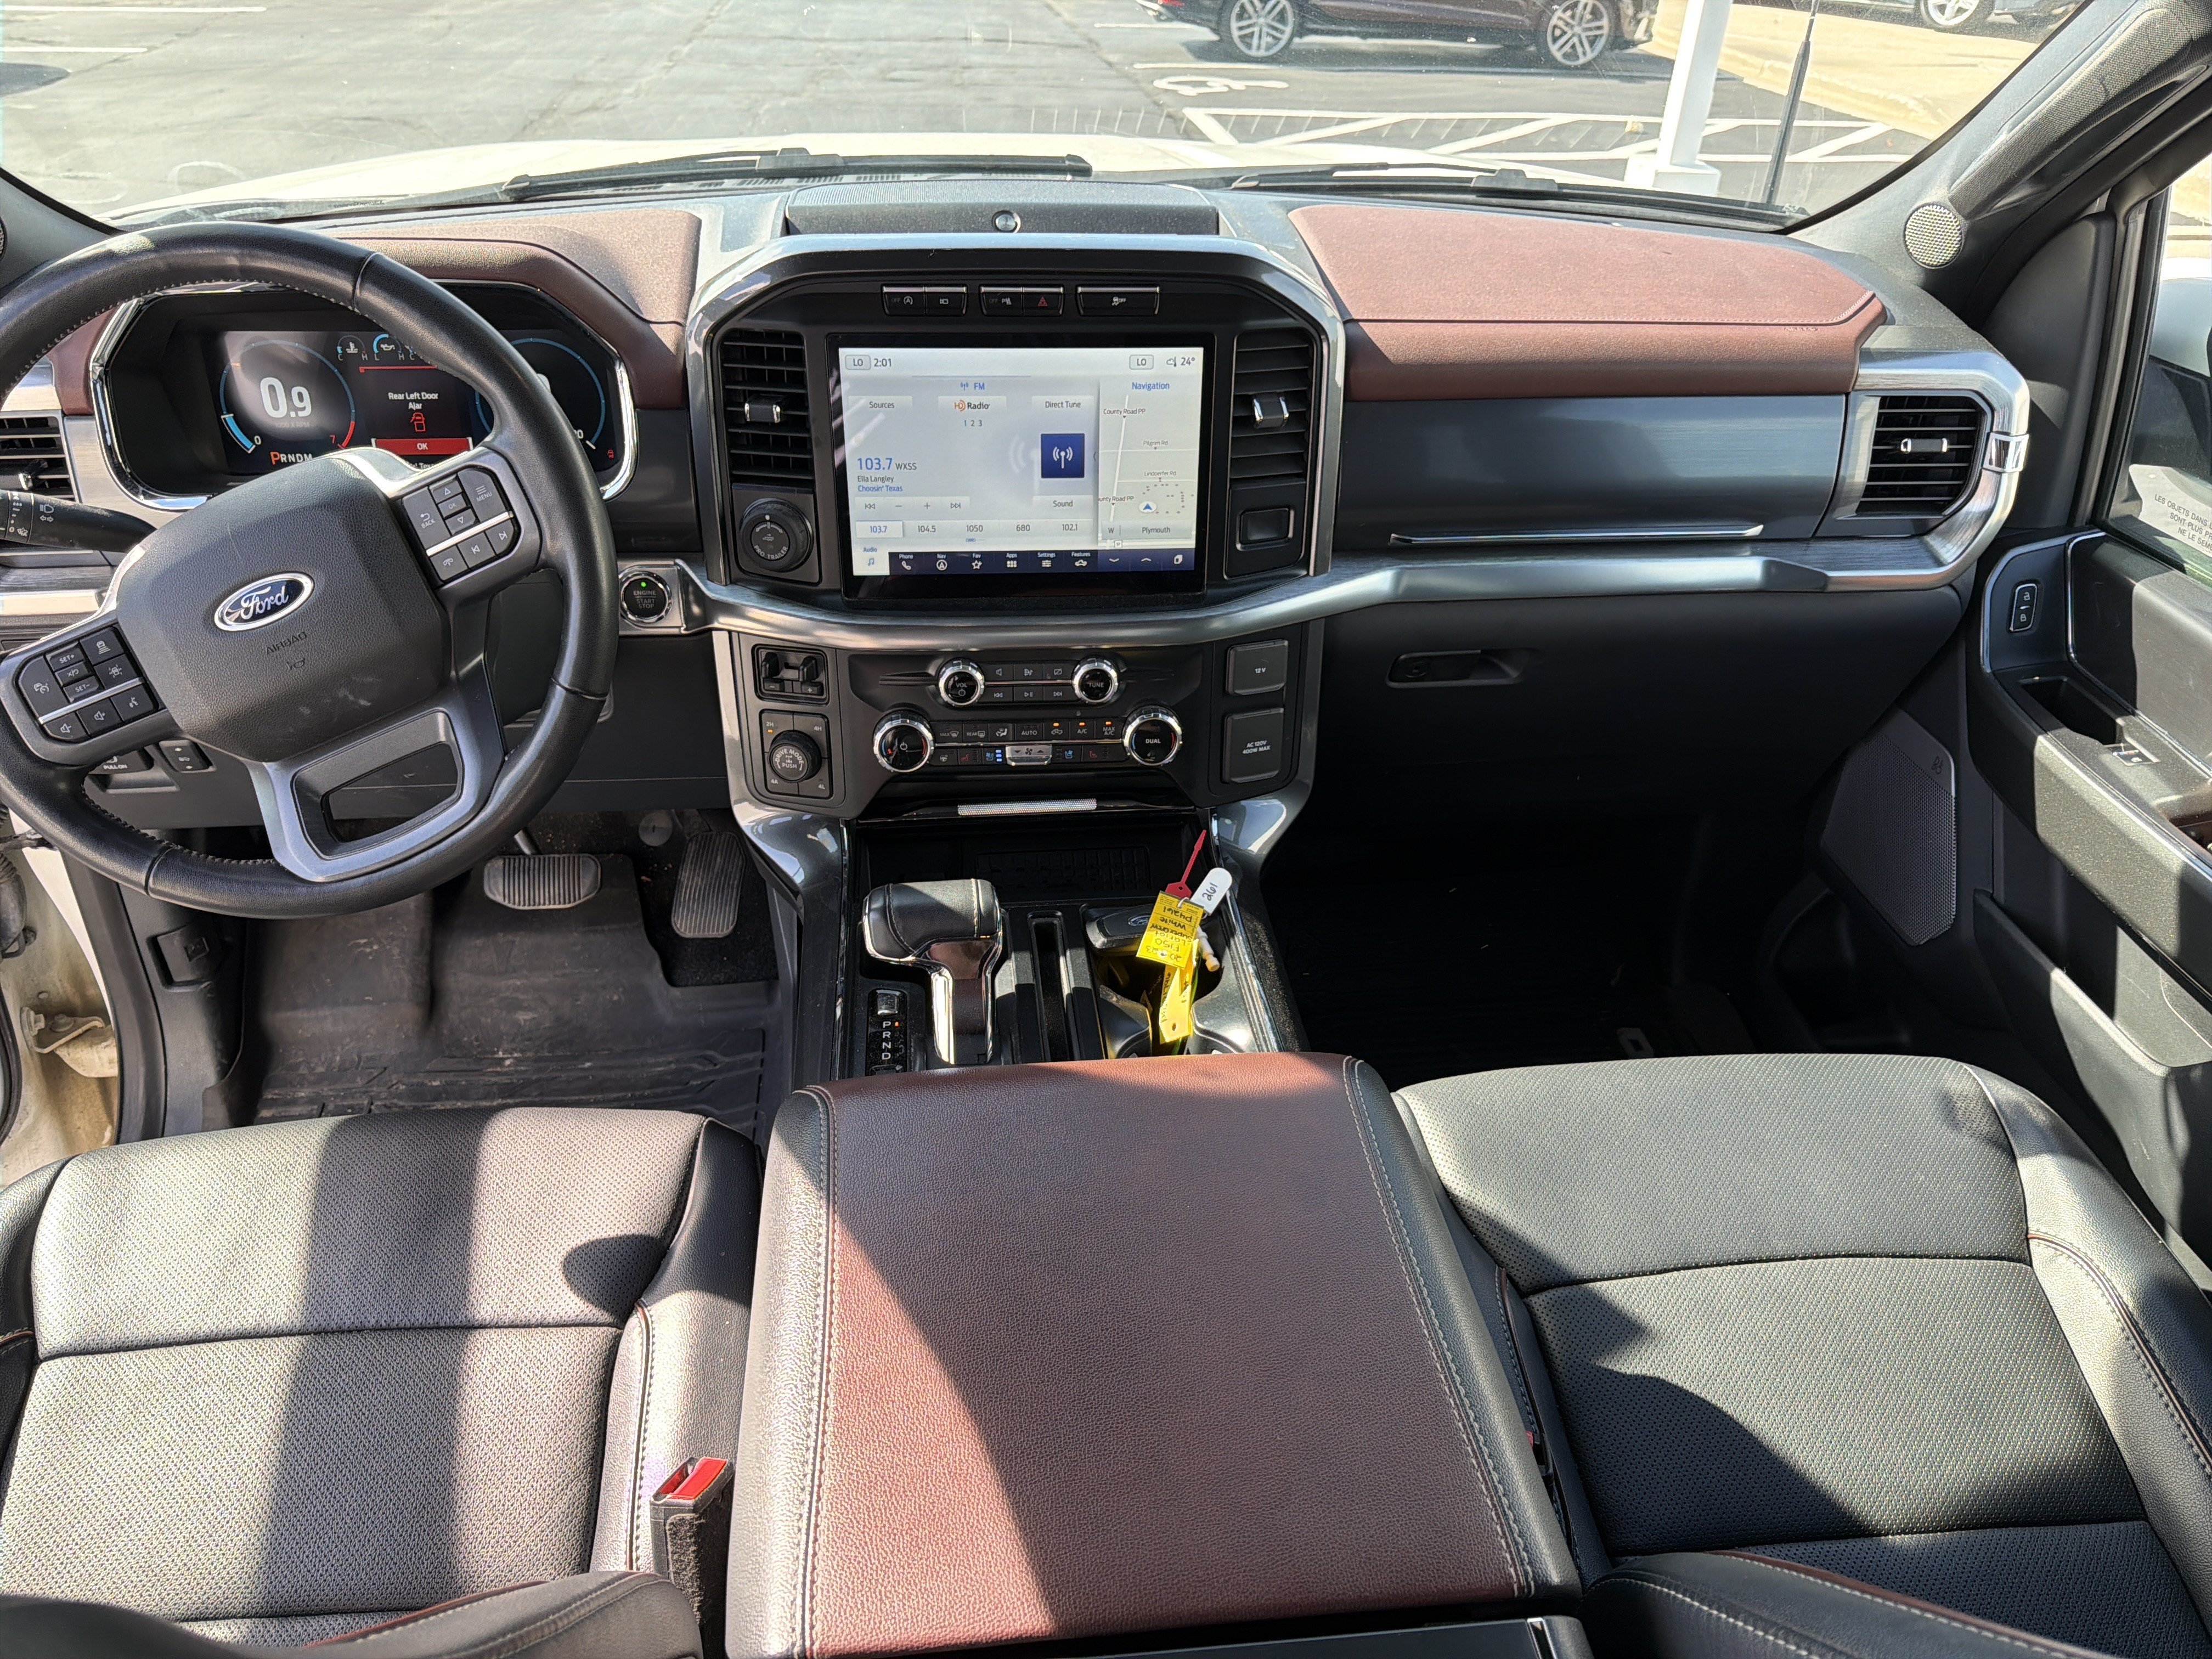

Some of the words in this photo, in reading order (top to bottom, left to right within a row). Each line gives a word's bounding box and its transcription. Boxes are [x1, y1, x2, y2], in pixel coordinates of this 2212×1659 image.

[853, 358, 864, 366] LO
[873, 358, 892, 367] 2:01
[1132, 382, 1170, 391] Navigation
[260, 377, 312, 418] 0.9
[408, 402, 422, 411] Ajar
[967, 402, 990, 410] Radio
[857, 458, 893, 470] 103.7
[476, 491, 493, 502] MENU
[2154, 494, 2166, 505] LES
[2167, 500, 2190, 517] OBJETS
[2191, 512, 2208, 526] DANS
[421, 518, 436, 529] BACK
[2170, 512, 2186, 525] SONT
[2187, 521, 2203, 534] PLUS
[1142, 526, 1171, 534] Plymouth
[2177, 527, 2187, 537] NE
[2188, 532, 2196, 541] LE
[754, 545, 765, 557] PRO
[767, 546, 788, 560] TRAILER
[240, 585, 289, 620] Ford
[266, 631, 308, 655] AIRBAG
[775, 748, 788, 763] DRIVE
[788, 749, 804, 764] MODE
[1201, 882, 1218, 901] 261
